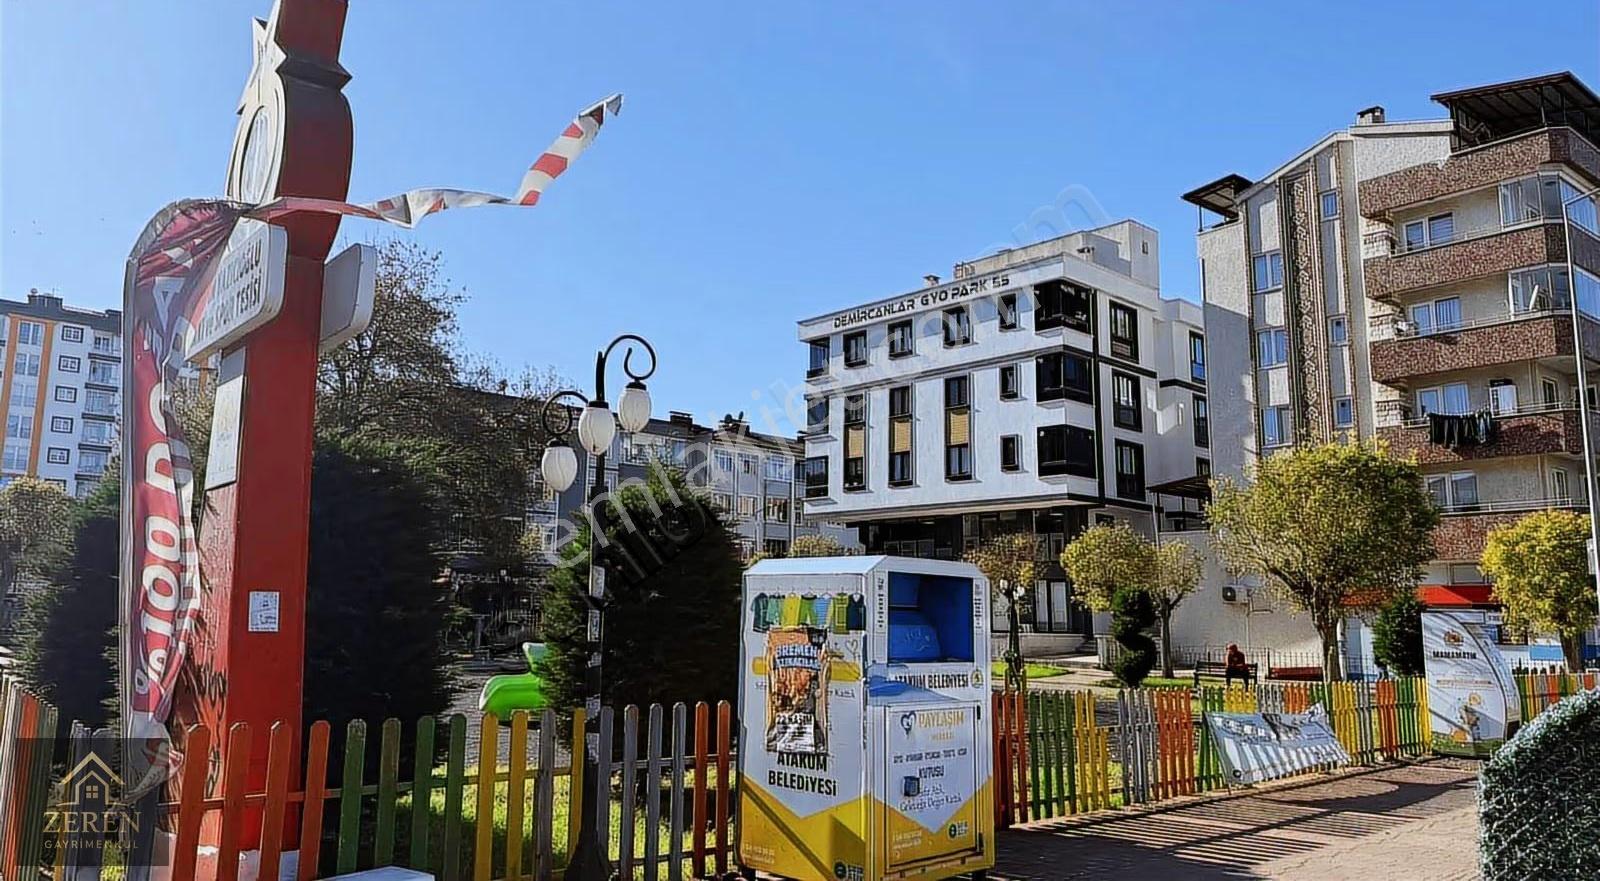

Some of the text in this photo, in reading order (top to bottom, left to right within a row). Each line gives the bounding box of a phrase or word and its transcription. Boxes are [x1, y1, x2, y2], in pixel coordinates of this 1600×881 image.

[833, 297, 916, 329] DEMİRCANLAR
[920, 289, 949, 306] GYO
[951, 279, 989, 300] PARK
[777, 751, 828, 772] ATAKUM
[768, 770, 837, 797] BELEDİYESİ
